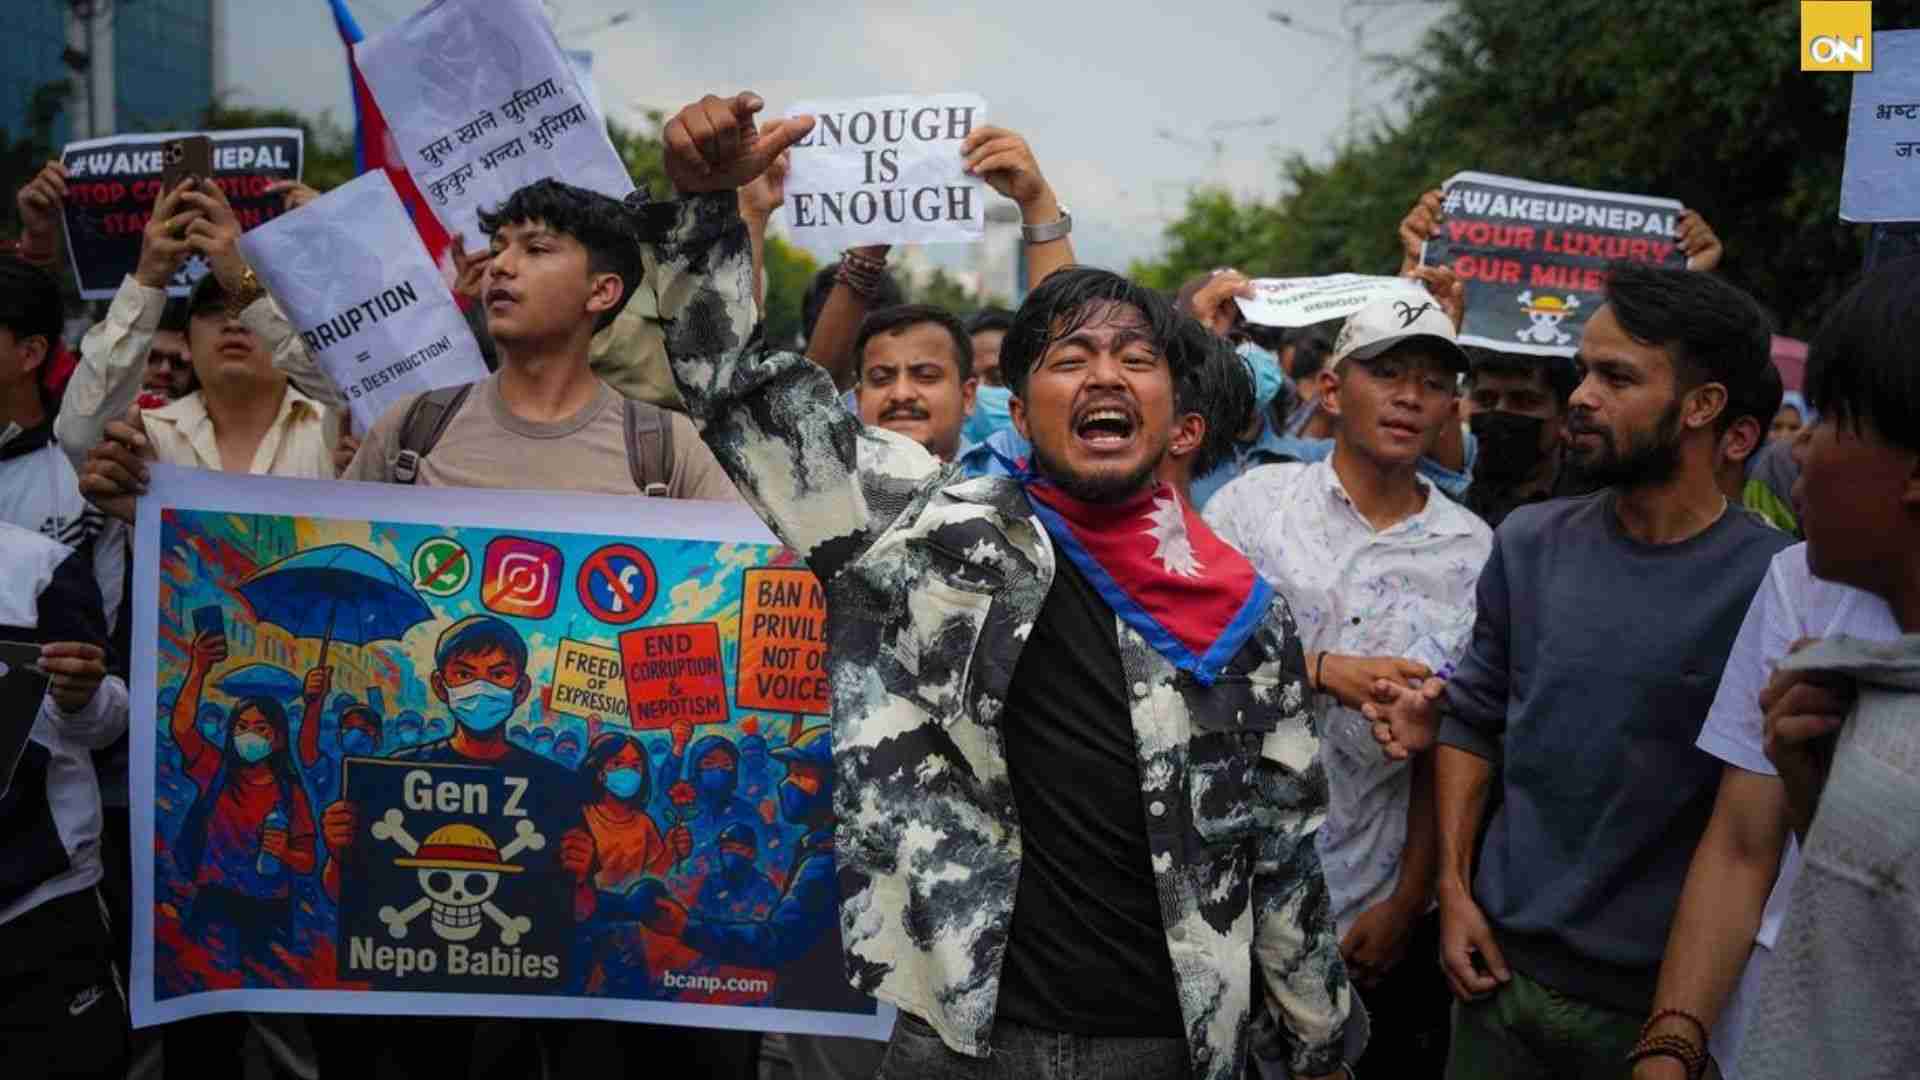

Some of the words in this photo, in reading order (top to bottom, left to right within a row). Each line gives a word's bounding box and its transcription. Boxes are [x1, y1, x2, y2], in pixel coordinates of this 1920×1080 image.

[792, 106, 976, 147] NOUGH
[861, 149, 899, 185] IS
[790, 186, 976, 228] ENOUGH
[1442, 190, 1678, 237] #WAKEUPNEPAL
[1449, 220, 1536, 251] YOUR
[1543, 229, 1675, 265] LUXURY
[1454, 253, 1523, 285] OUR
[1531, 264, 1610, 292] MISE
[361, 336, 453, 392] DESTRUCTION!
[757, 580, 801, 608] BAN
[644, 633, 693, 657] END
[762, 646, 801, 670] NOT
[564, 650, 625, 680] FREED
[630, 656, 719, 682] CORRUPTION
[587, 678, 608, 689] OF
[668, 680, 681, 698] &
[555, 684, 628, 716] EXPRESSIO
[637, 695, 720, 720] NEPOTISM
[403, 768, 489, 815] Gen
[502, 776, 530, 817] Z
[349, 935, 438, 978] Nepo
[447, 943, 560, 979] Babies
[663, 969, 769, 994] bcanp.com
